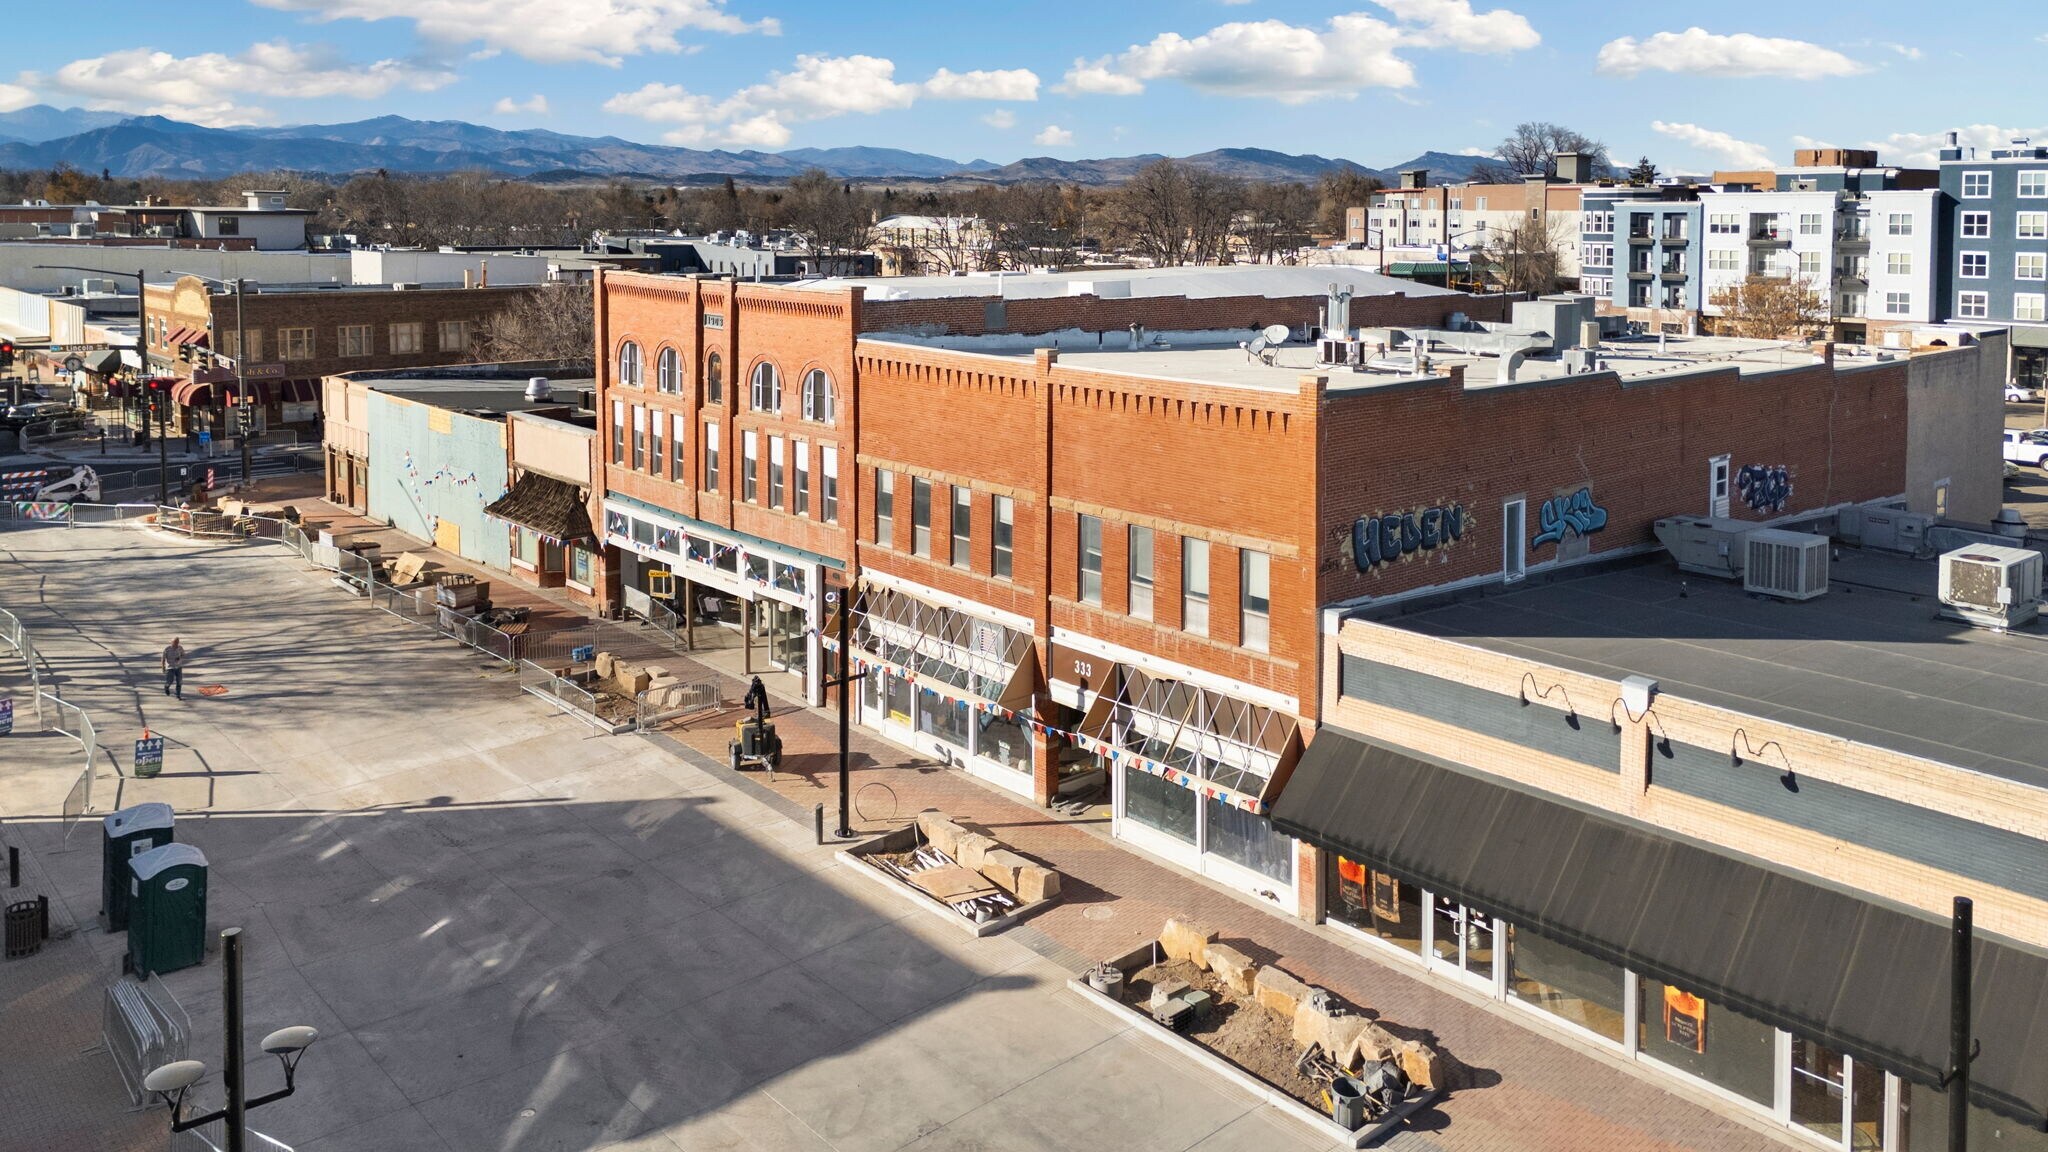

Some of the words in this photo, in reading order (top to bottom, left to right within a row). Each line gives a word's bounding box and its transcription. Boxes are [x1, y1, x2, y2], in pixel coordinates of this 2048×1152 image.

[66, 344, 94, 352] Lincoln
[1074, 660, 1091, 677] 333
[136, 756, 161, 766] open
